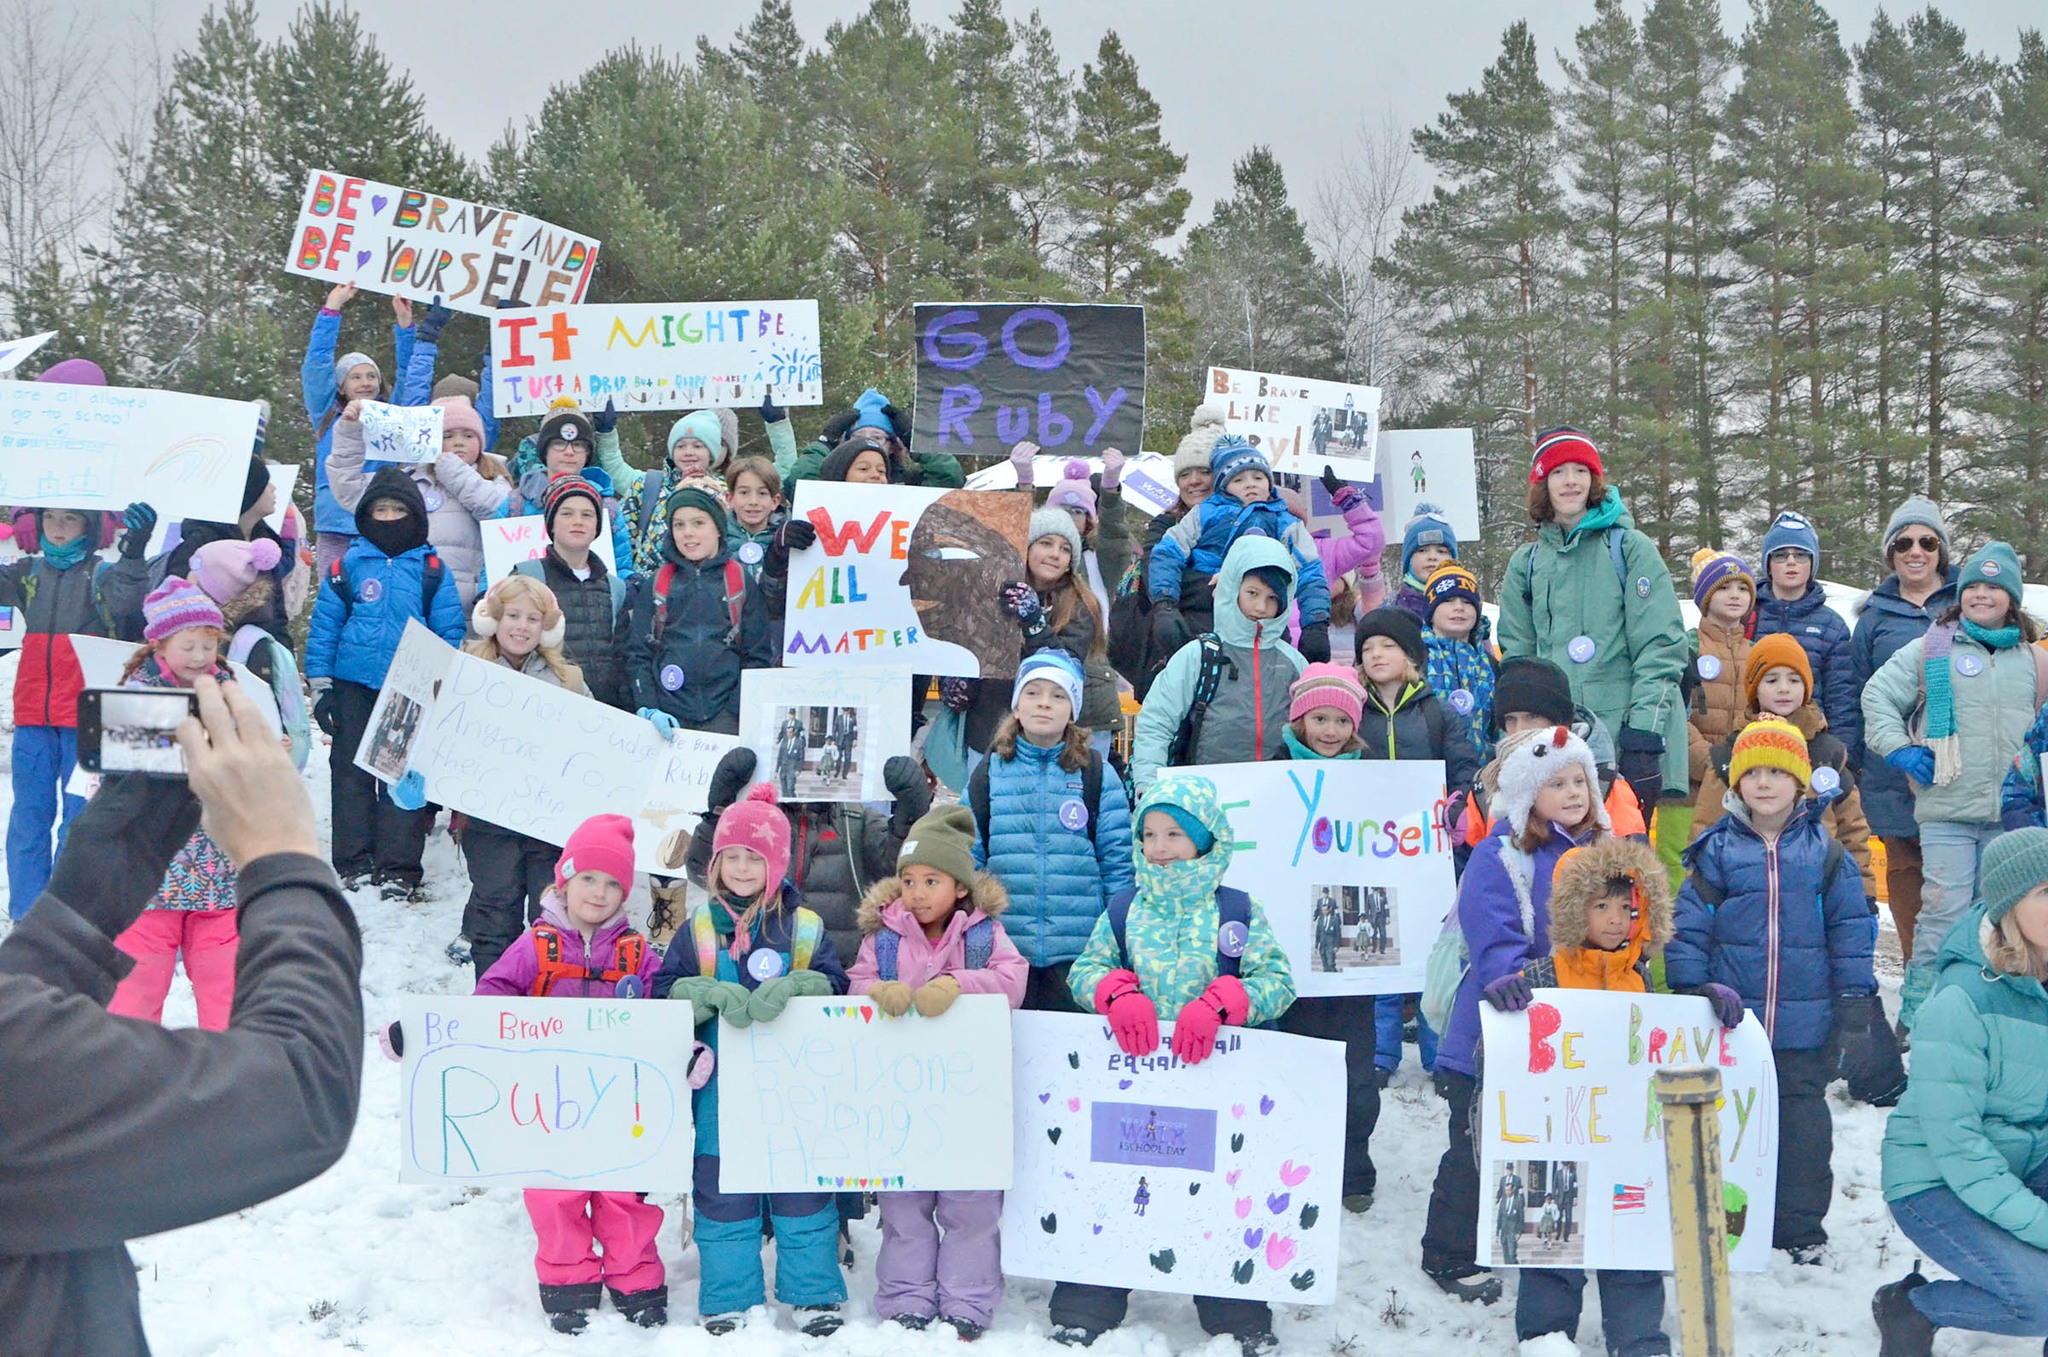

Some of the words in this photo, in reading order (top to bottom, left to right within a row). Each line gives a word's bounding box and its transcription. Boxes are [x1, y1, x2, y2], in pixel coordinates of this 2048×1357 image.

[309, 175, 366, 220] BE
[393, 190, 519, 248] BRAVE
[521, 226, 587, 272] AND
[297, 224, 353, 270] BE
[381, 237, 597, 306] YOURSELF!
[608, 309, 750, 350] MIGHT
[759, 310, 785, 337] BE
[923, 308, 1072, 371] GO
[573, 375, 582, 393] A
[806, 506, 909, 559] WE
[796, 565, 867, 609] ALL
[787, 627, 918, 654] MATTER
[665, 756, 709, 785] Rub
[425, 1012, 459, 1046] Be
[500, 1012, 564, 1040] Brave
[751, 1028, 979, 1096] Everyone
[1108, 1054, 1187, 1074] equal
